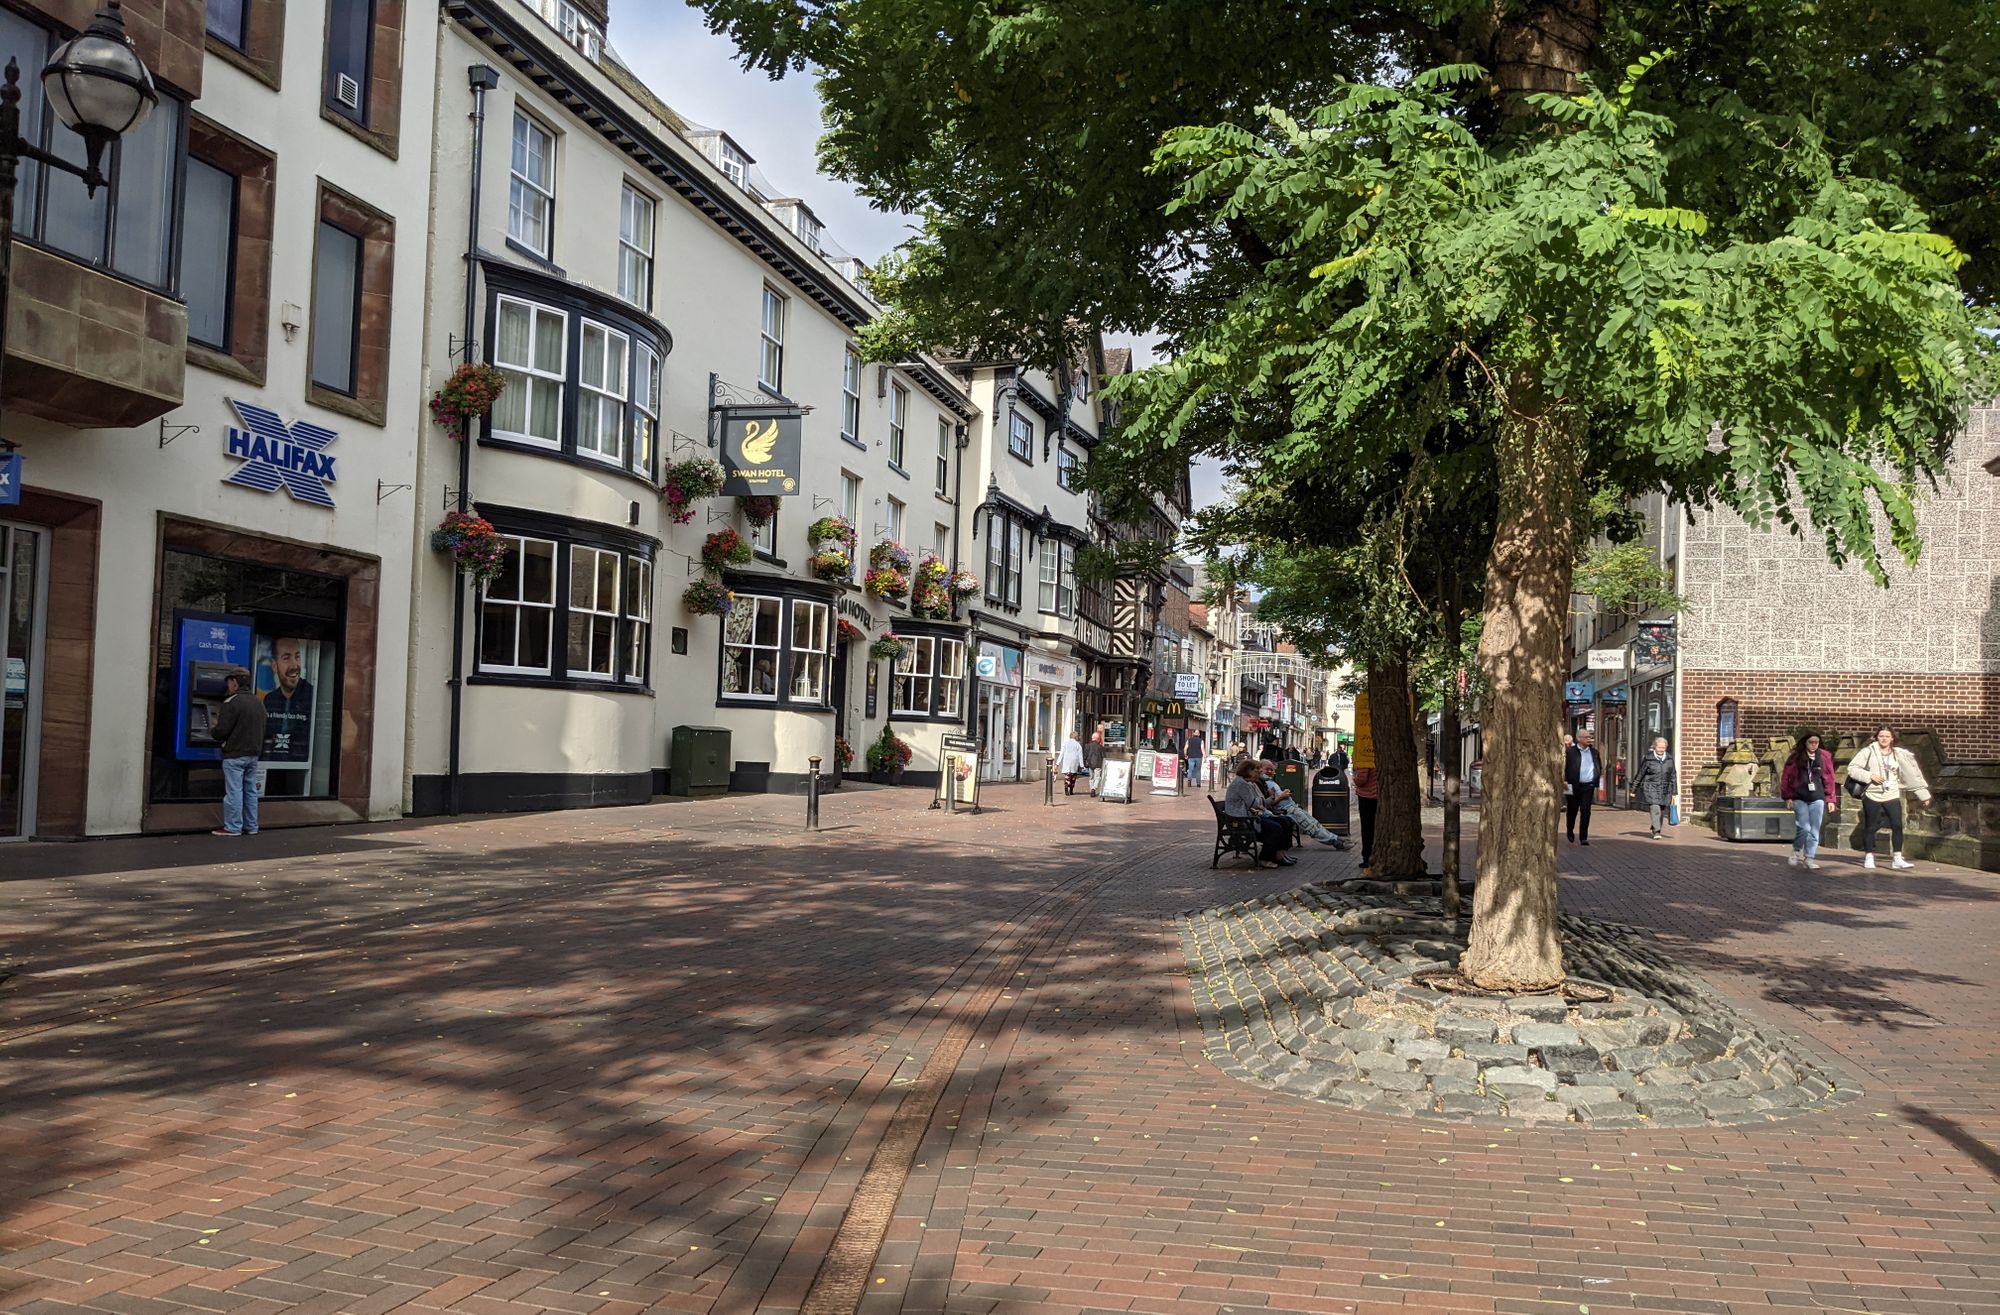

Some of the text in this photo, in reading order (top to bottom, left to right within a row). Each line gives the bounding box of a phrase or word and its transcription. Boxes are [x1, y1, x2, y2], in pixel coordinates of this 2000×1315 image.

[229, 427, 337, 481] HALIFAX
[732, 469, 786, 478] SWAN HOTEL
[848, 601, 872, 631] HOTEL
